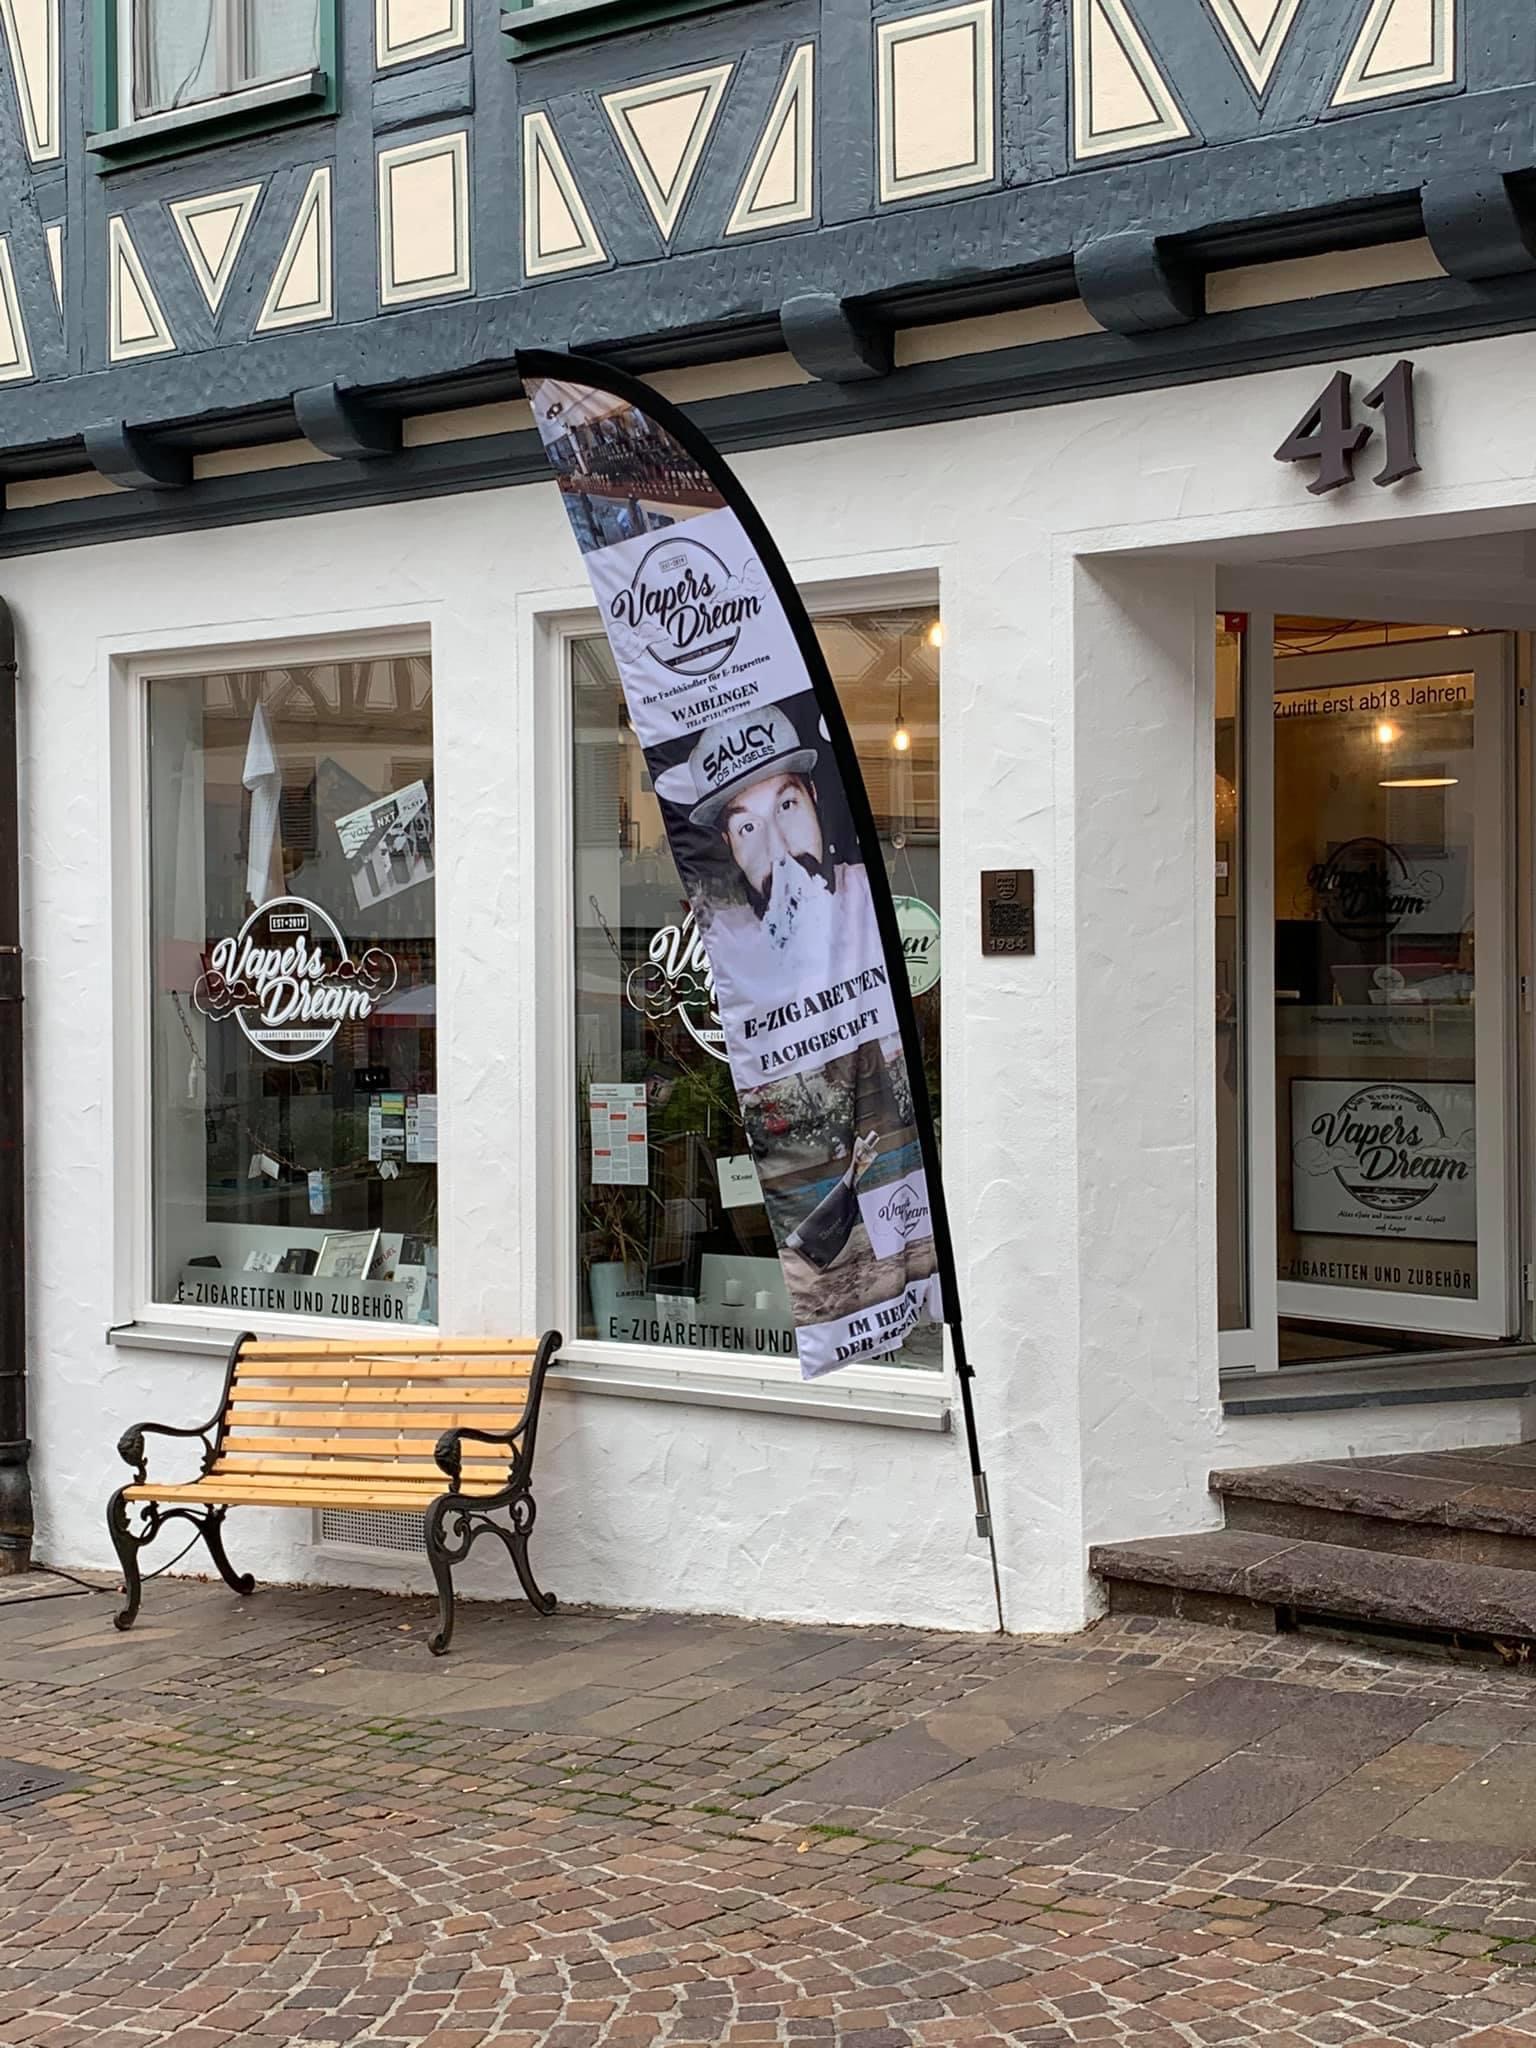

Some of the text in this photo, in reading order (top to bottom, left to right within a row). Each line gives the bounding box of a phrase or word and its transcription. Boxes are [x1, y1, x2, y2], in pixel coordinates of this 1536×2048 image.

[1273, 359, 1423, 496] 41
[610, 568, 716, 627] Vapers
[666, 595, 762, 649] Dream
[642, 694, 658, 705] Ihr
[731, 653, 771, 674] Zigaretten
[707, 683, 719, 694] IN
[670, 680, 760, 723] WAIBLINGEN
[1273, 699, 1318, 719] Zutritt
[1322, 694, 1355, 714] erst
[1405, 685, 1467, 706] Jahren
[702, 722, 776, 783] SAUCY
[713, 744, 776, 786] LOS ANGELES
[211, 935, 326, 994] Vapers
[260, 975, 372, 1027] Dream
[1311, 1112, 1424, 1157] Vapers
[1359, 1145, 1469, 1182] Dream
[1281, 1260, 1472, 1290] -ZIGARETTEN UND ZUBEHÖR
[177, 1281, 405, 1320] E-ZIGARETTEN UND ZUBEHÖR
[609, 1316, 793, 1354] E-ZIGARETTEN UND
[834, 1336, 875, 1361] DER
[847, 1320, 873, 1338] IM
